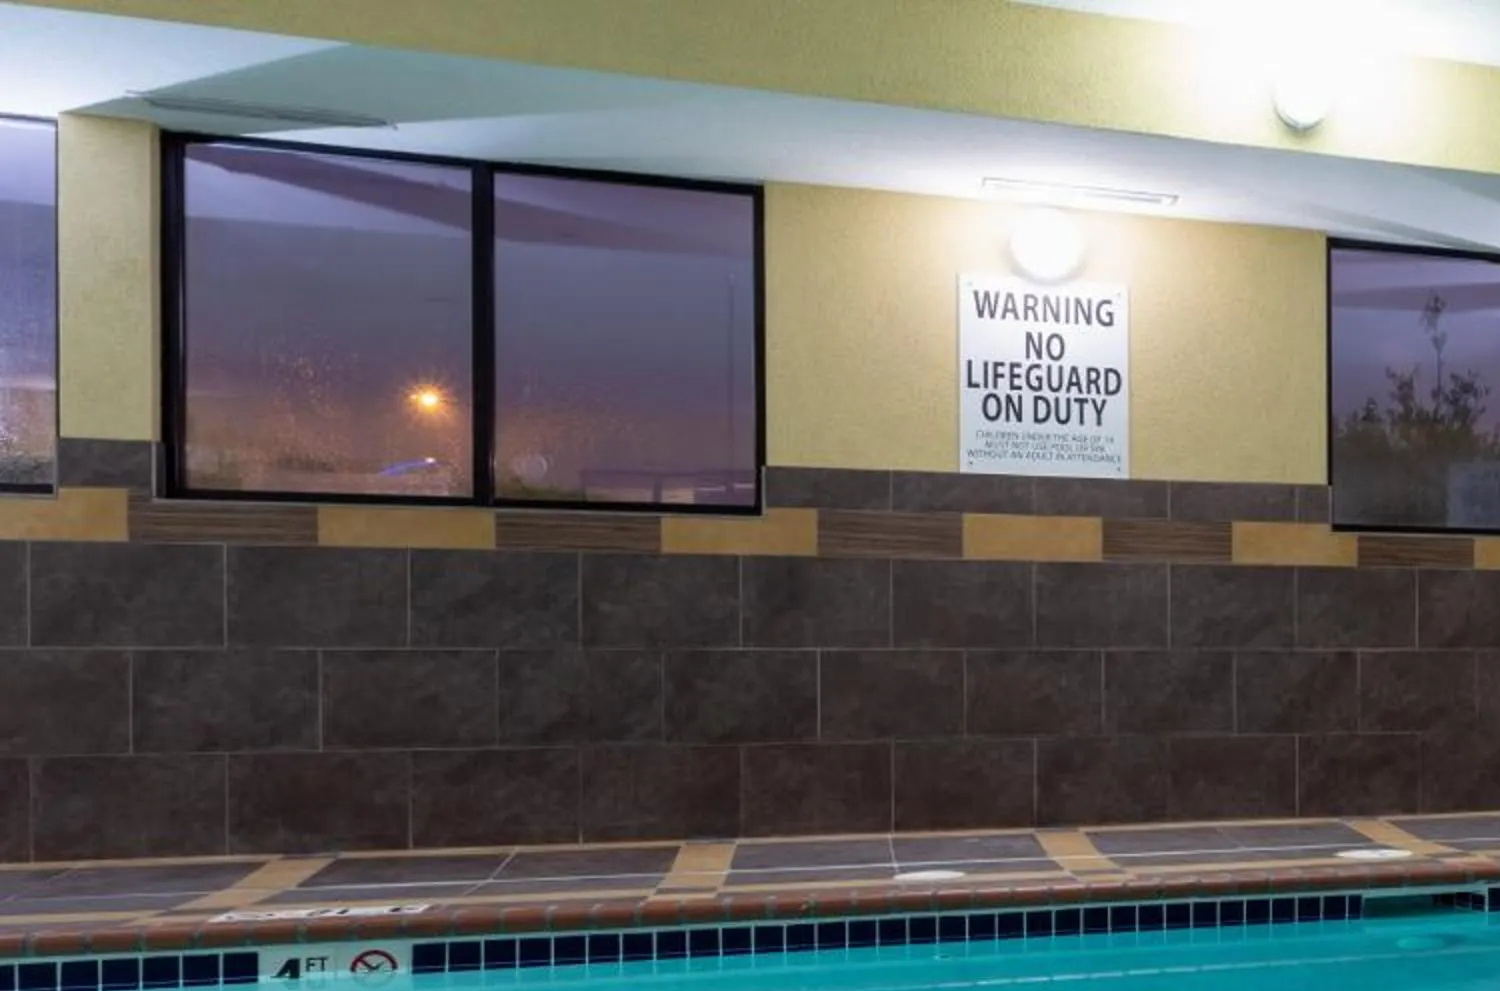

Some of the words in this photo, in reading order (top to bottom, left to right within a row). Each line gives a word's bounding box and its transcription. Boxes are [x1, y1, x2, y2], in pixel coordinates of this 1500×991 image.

[973, 289, 1115, 327] WARNING
[1025, 331, 1065, 361] NO
[966, 359, 1122, 396] LIFEGUARD
[981, 393, 1023, 423] ON
[1033, 395, 1107, 427] DUTY
[976, 430, 1019, 440] CHILDREN
[1021, 432, 1051, 440] UNDER
[1053, 433, 1069, 442] THE
[1071, 434, 1088, 443] AGE
[1090, 435, 1102, 443] OF
[984, 440, 1009, 448] MUST
[1011, 441, 1030, 449] NOT
[1032, 442, 1047, 450] USE
[1051, 443, 1073, 452] POOL
[967, 449, 1008, 459] WITHOUT
[1009, 451, 1023, 459] AN
[1025, 451, 1053, 461] ADULT
[1055, 453, 1065, 461] IN
[1066, 453, 1121, 464] ATTENDANCE
[272, 958, 301, 979] 4
[305, 956, 329, 972] FT
